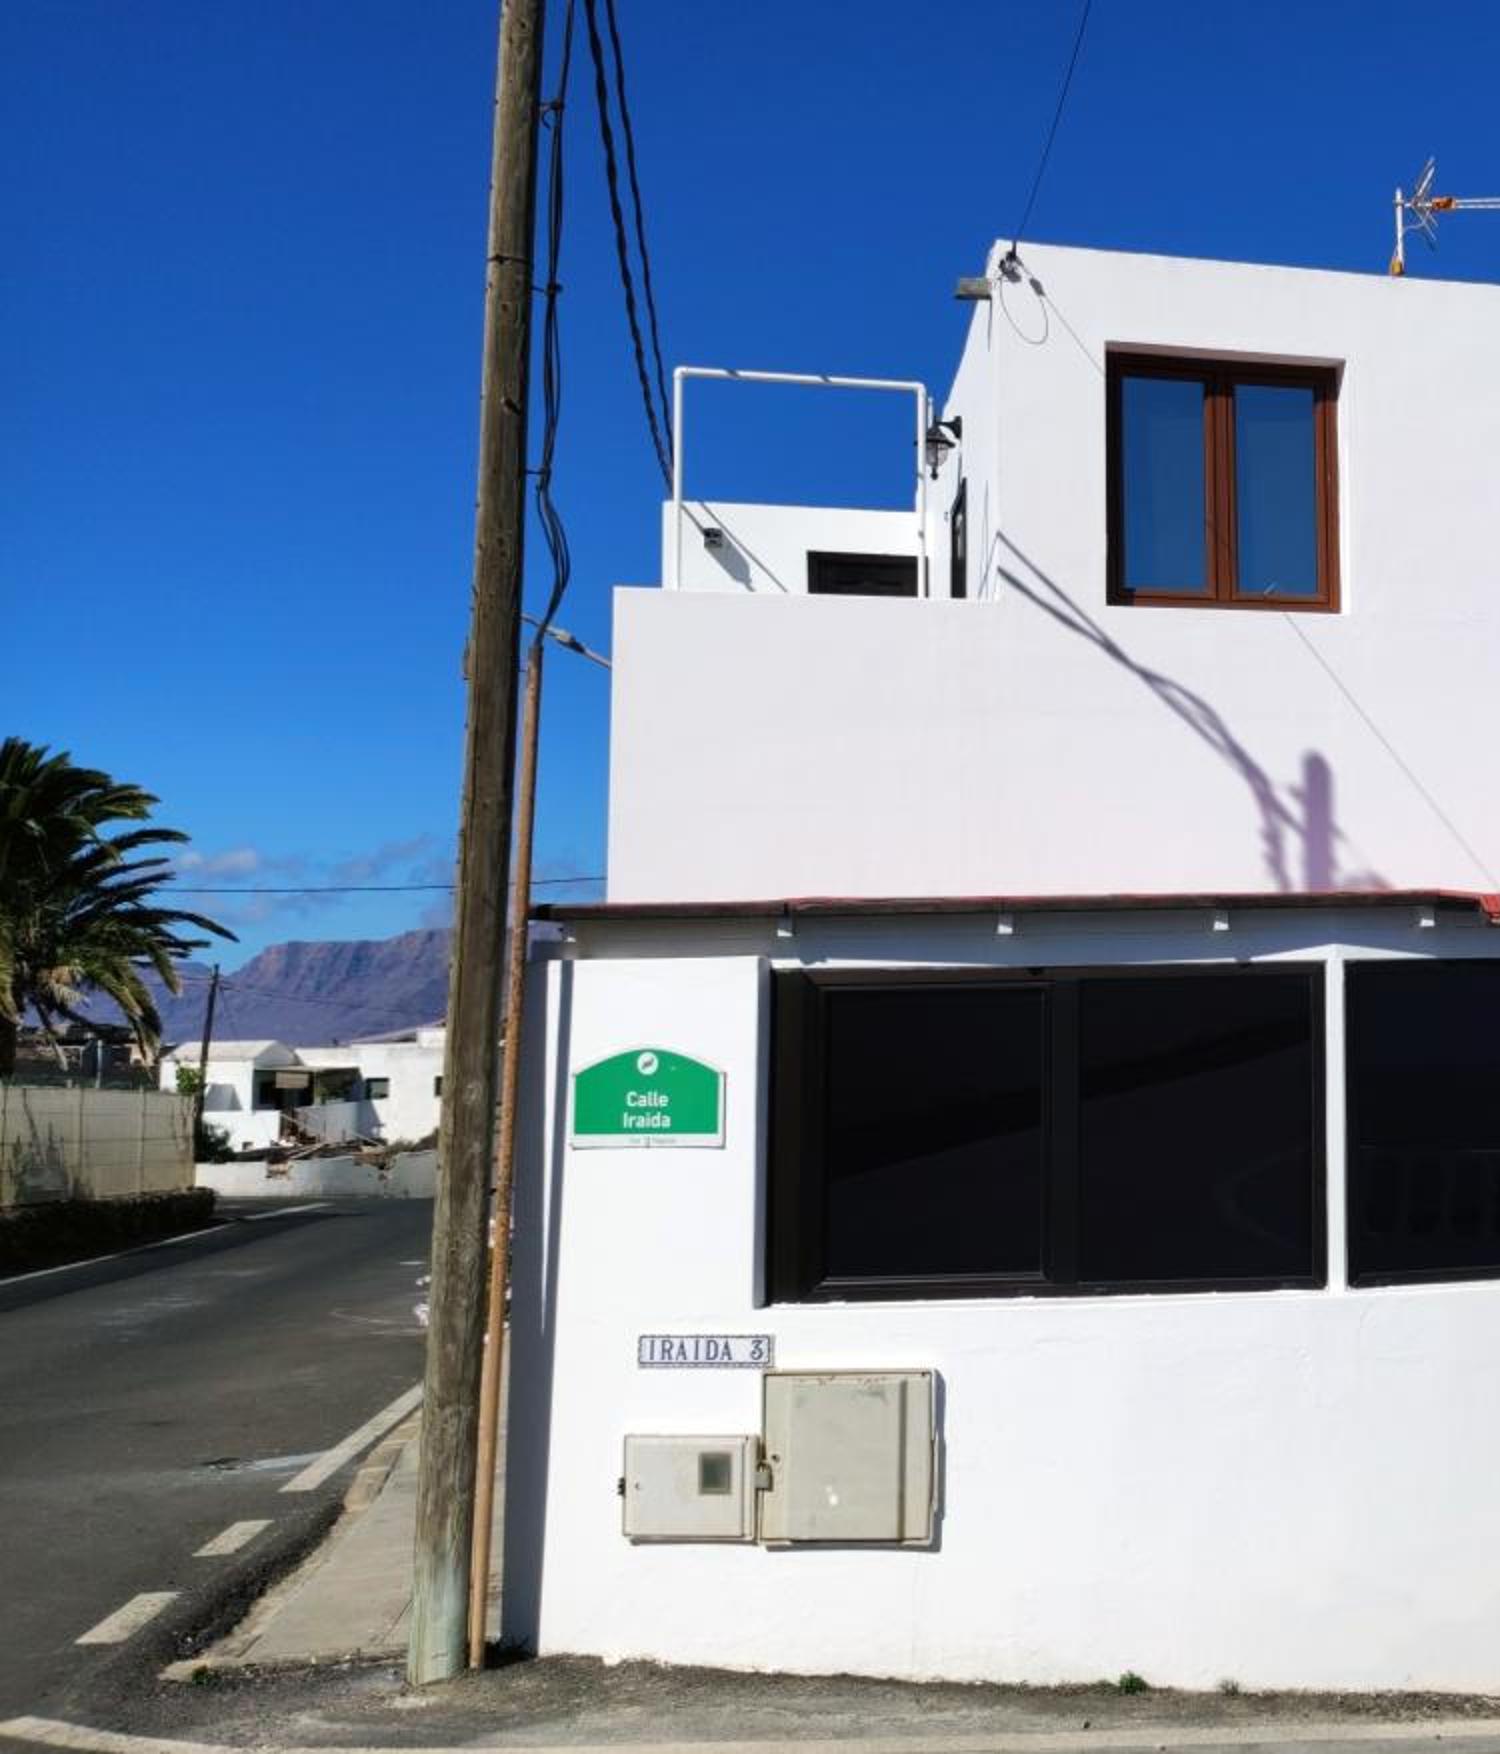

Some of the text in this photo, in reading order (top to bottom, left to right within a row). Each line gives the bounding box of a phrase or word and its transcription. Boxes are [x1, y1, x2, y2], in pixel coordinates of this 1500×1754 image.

[626, 1091, 669, 1107] Calle
[623, 1112, 671, 1128] Iraida
[649, 1339, 764, 1361] IRAIDA 3
